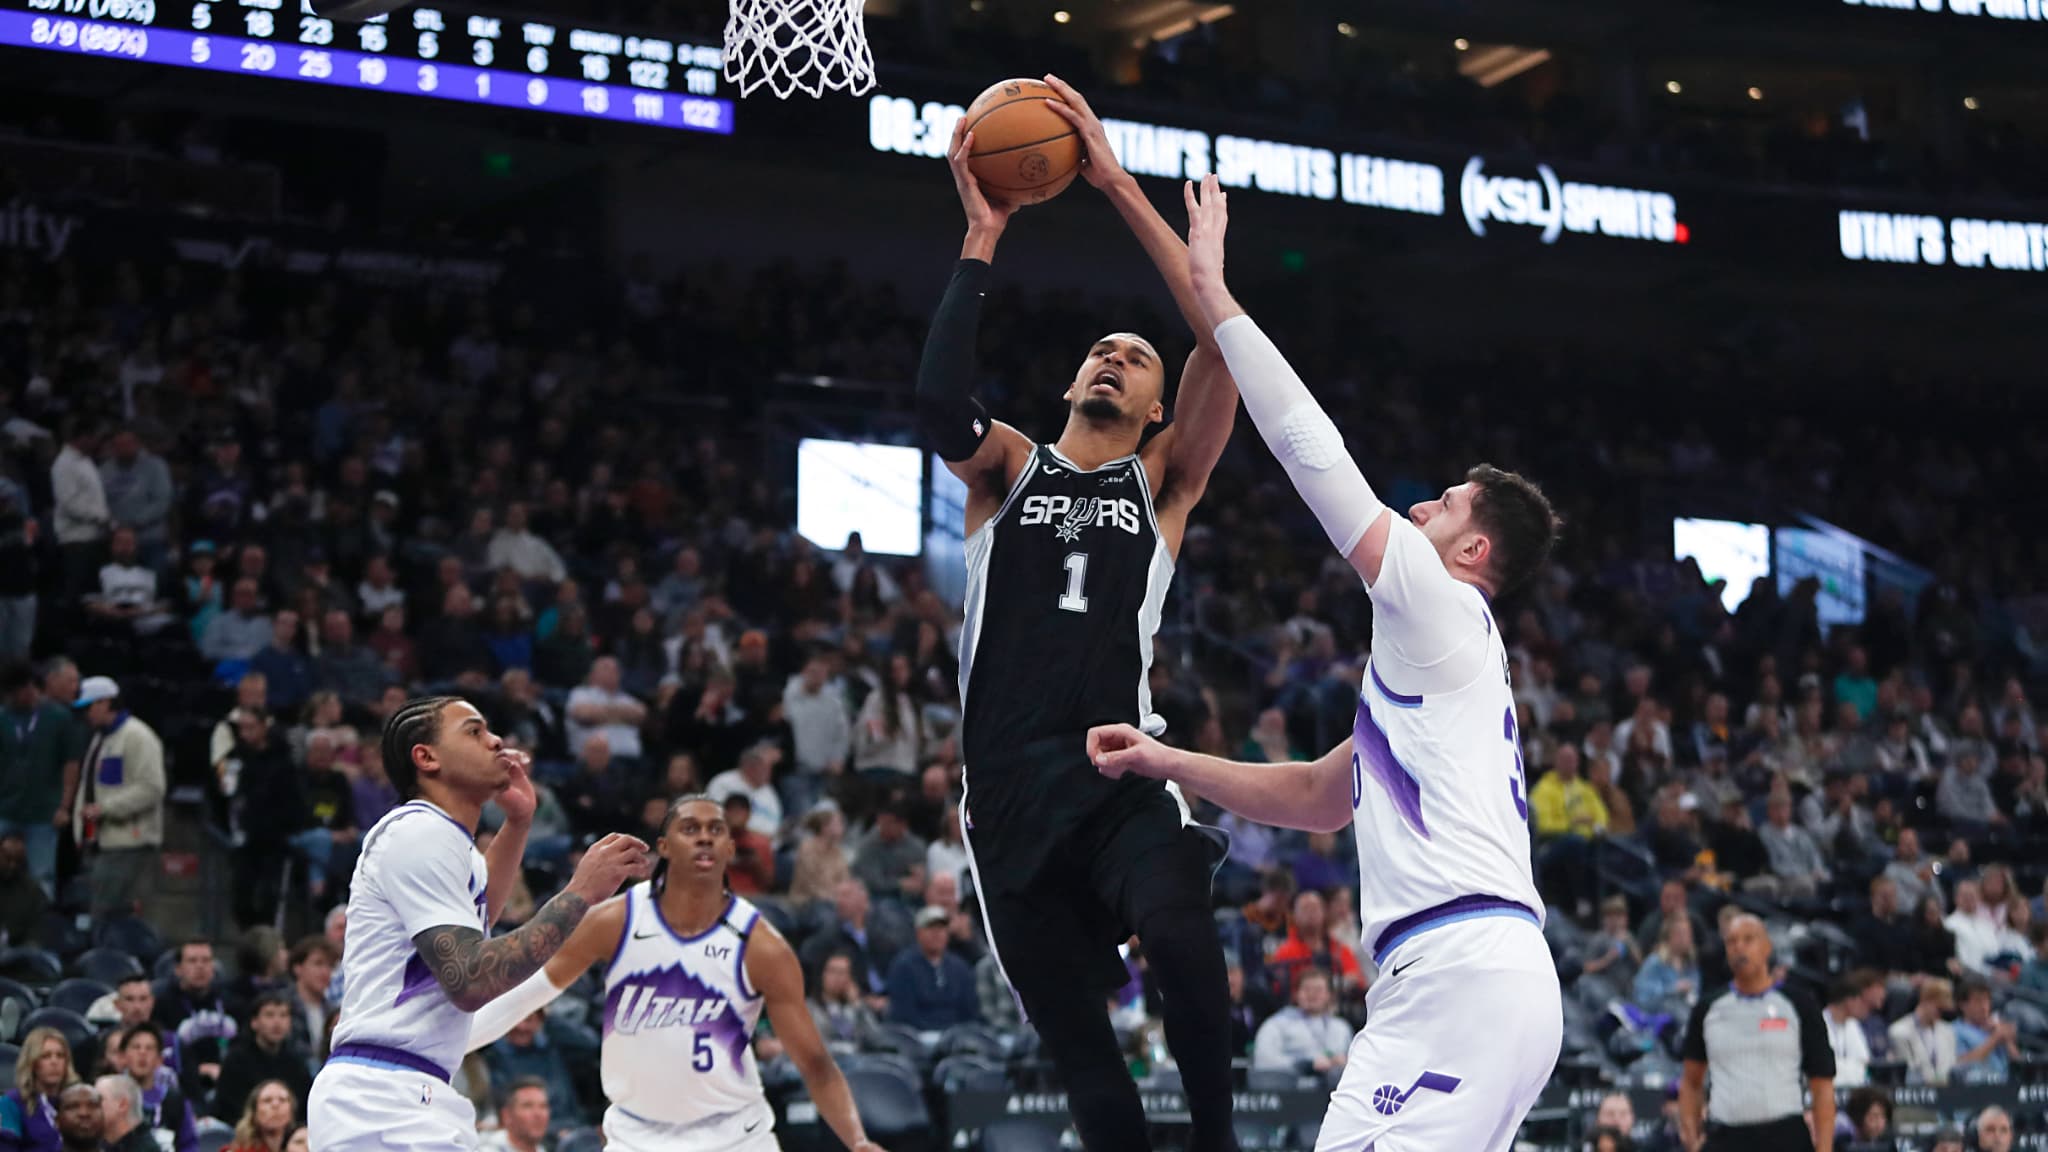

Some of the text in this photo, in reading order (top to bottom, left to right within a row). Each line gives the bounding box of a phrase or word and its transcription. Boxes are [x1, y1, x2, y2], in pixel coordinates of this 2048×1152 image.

[31, 18, 78, 46] 8/9
[192, 37, 210, 63] 5
[241, 44, 276, 71] 20
[299, 51, 332, 78] 25
[418, 65, 437, 91] 3
[476, 74, 490, 97] 1
[528, 79, 548, 105] 9
[633, 94, 663, 119] 111
[681, 100, 720, 128] 122
[193, 4, 211, 28] 5
[300, 17, 332, 44] 23
[419, 32, 438, 57] 5
[474, 40, 493, 65] 3
[528, 47, 547, 72] 6
[629, 62, 667, 88] 122
[686, 70, 715, 93] 111
[1215, 135, 1336, 200] SPORTS
[1340, 152, 1445, 216] LEADER
[1839, 210, 2048, 271] UTAH'S SPORT
[1020, 495, 1140, 535] SPURS
[1059, 552, 1089, 613] 1
[692, 1032, 714, 1073] 5
[1023, 1094, 1068, 1112] DELT
